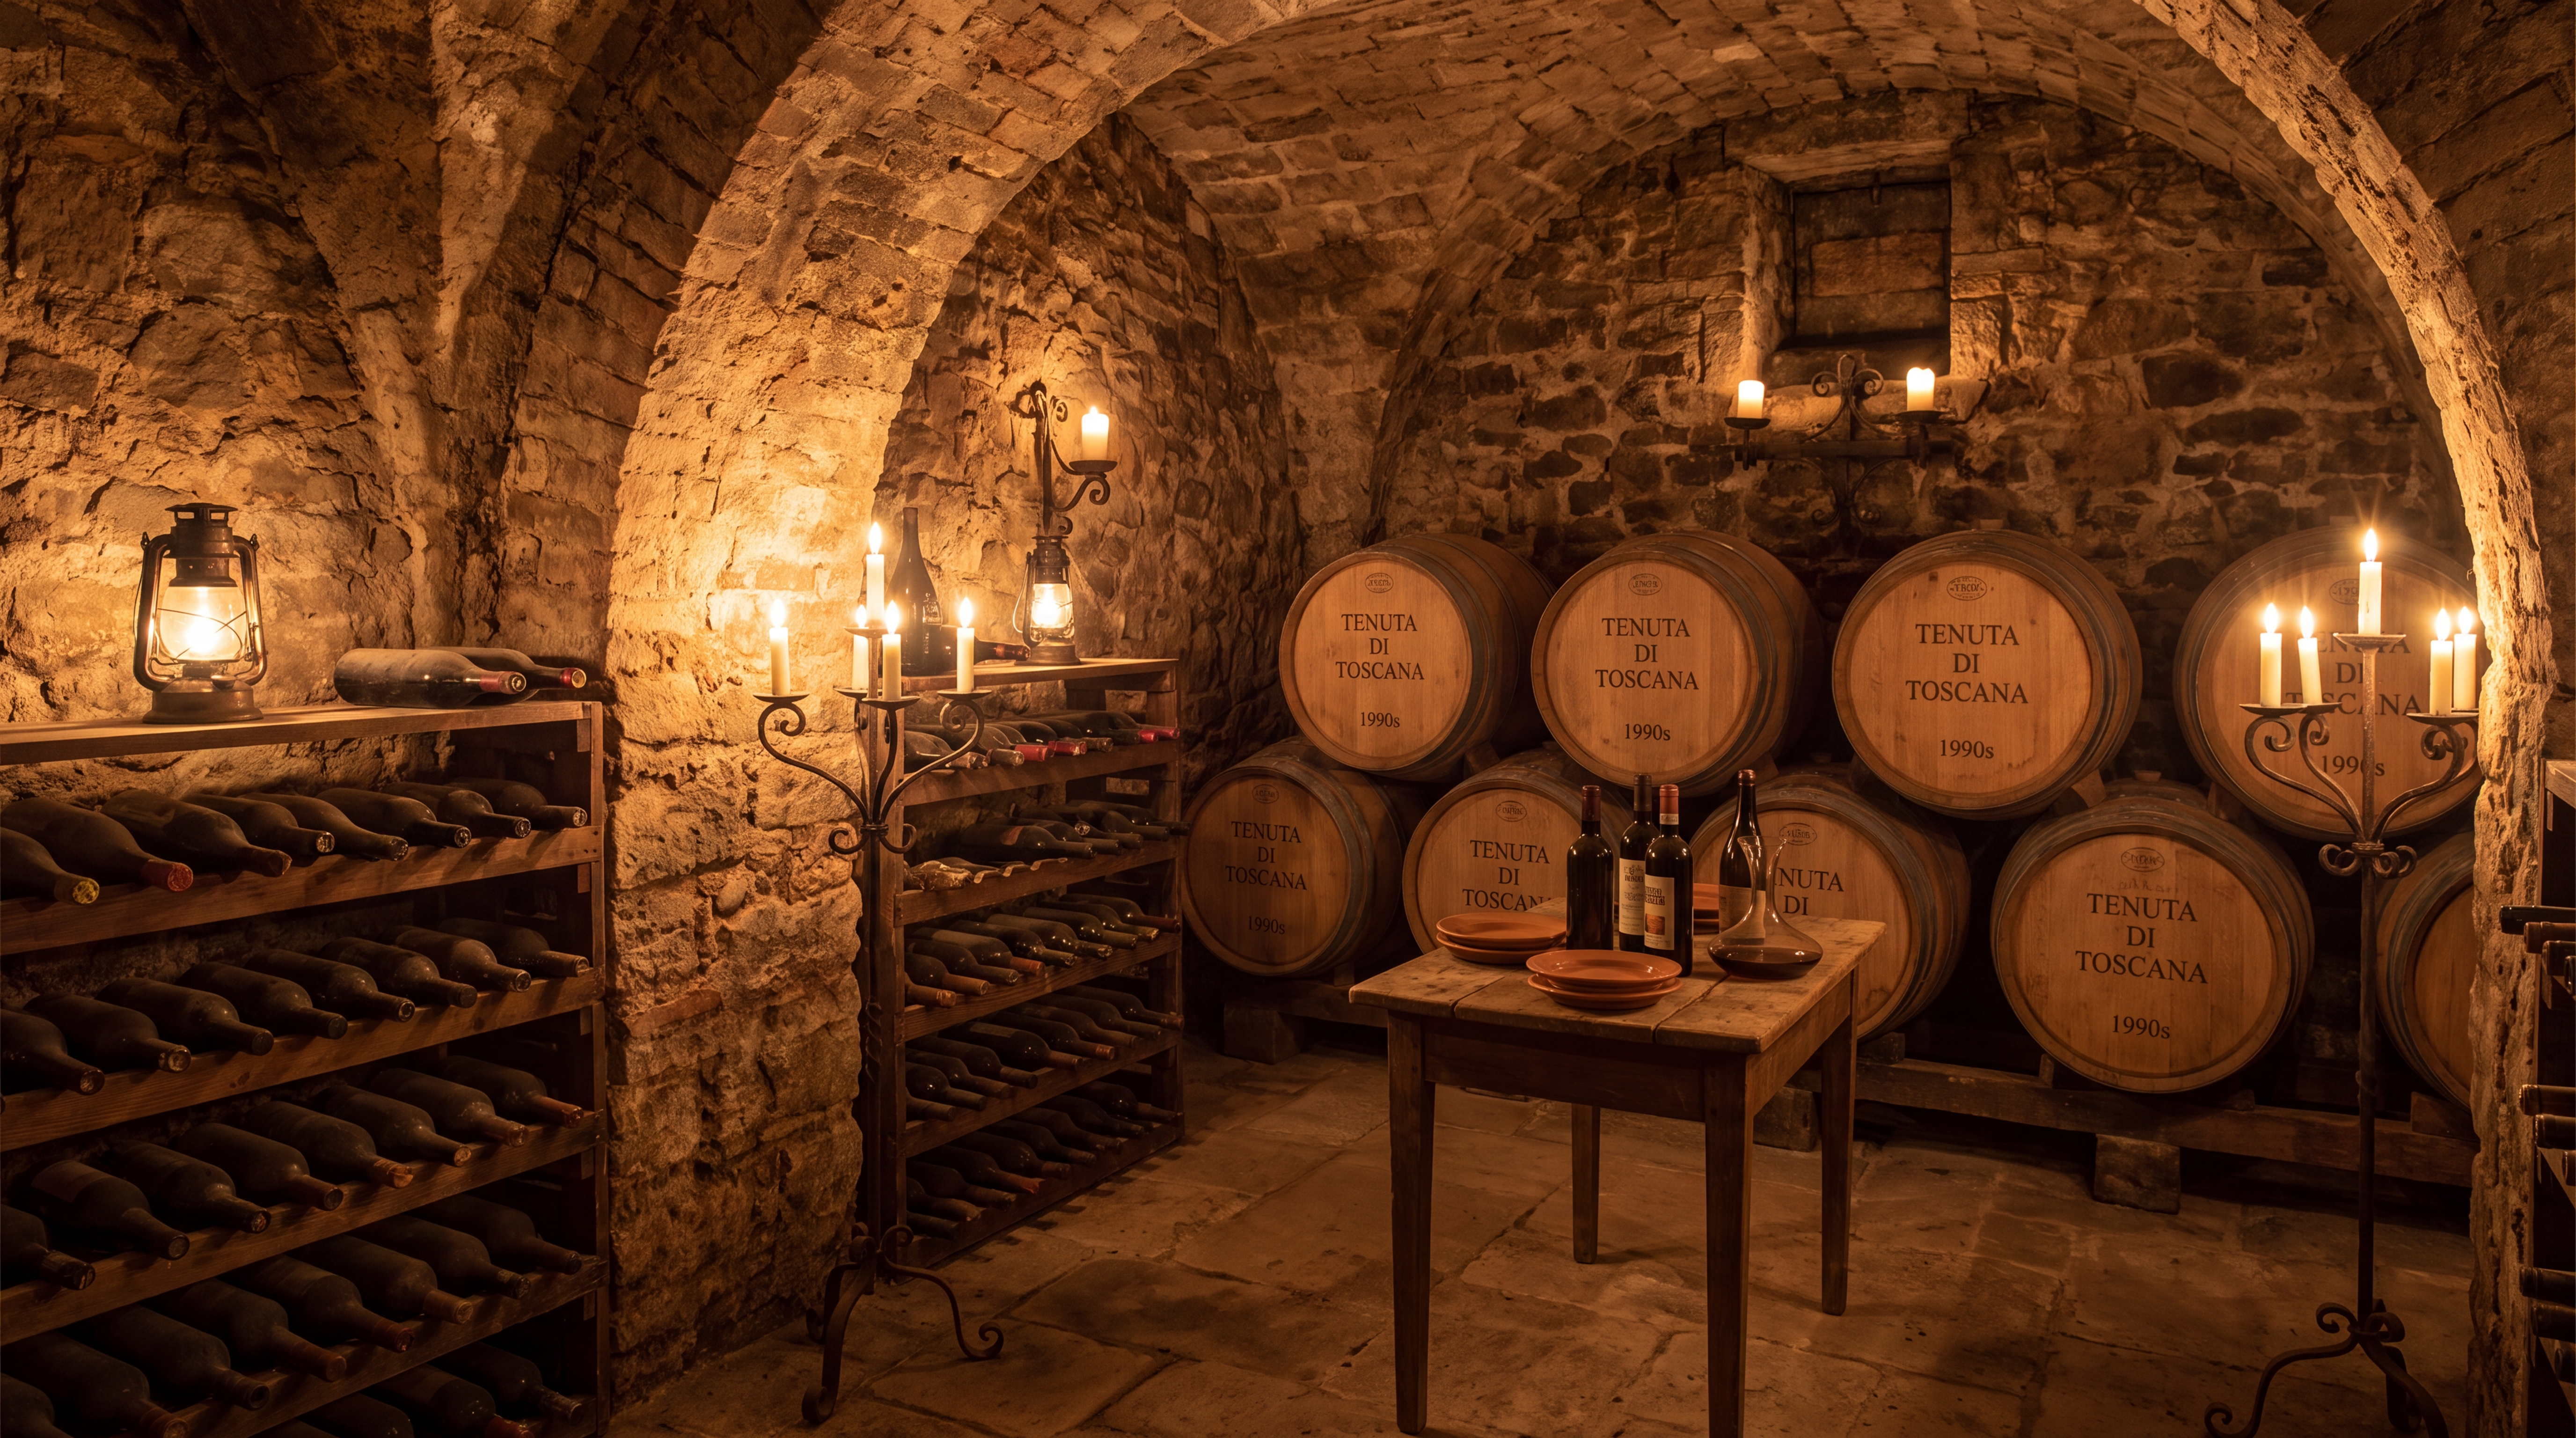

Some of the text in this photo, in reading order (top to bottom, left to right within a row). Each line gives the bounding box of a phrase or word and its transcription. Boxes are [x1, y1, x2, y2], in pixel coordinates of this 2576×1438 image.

[1341, 614, 1418, 631] TENUTA
[1602, 618, 1690, 637] TENUTA
[1915, 624, 2020, 646] TENUTA
[1369, 638, 1389, 655] DI
[1634, 644, 1658, 662] DI
[1335, 661, 1425, 680] TOSCANA
[1953, 653, 1980, 674] DI
[1595, 669, 1699, 690] TOSCANA
[1905, 680, 2029, 704] TOSCANA
[1361, 712, 1400, 728] 1990s
[1625, 723, 1671, 741] 1990s
[1940, 739, 1994, 759] 1990s
[2322, 755, 2386, 777] 199s
[1231, 821, 1302, 843] TENUTA
[1257, 846, 1275, 863] DI
[1470, 840, 1550, 864] TENUTA
[1225, 865, 1307, 890] TOSCANA
[1498, 867, 1520, 886] DI
[1774, 867, 1844, 892] NUTA
[1462, 888, 1551, 911] TOSCAN
[1783, 895, 1809, 916] DI
[2086, 893, 2198, 922] TENUTA
[1249, 916, 1285, 935] 1990s
[2126, 925, 2156, 948] DI
[2075, 950, 2208, 984] TOSCANA
[2113, 1015, 2170, 1039] 1990s
